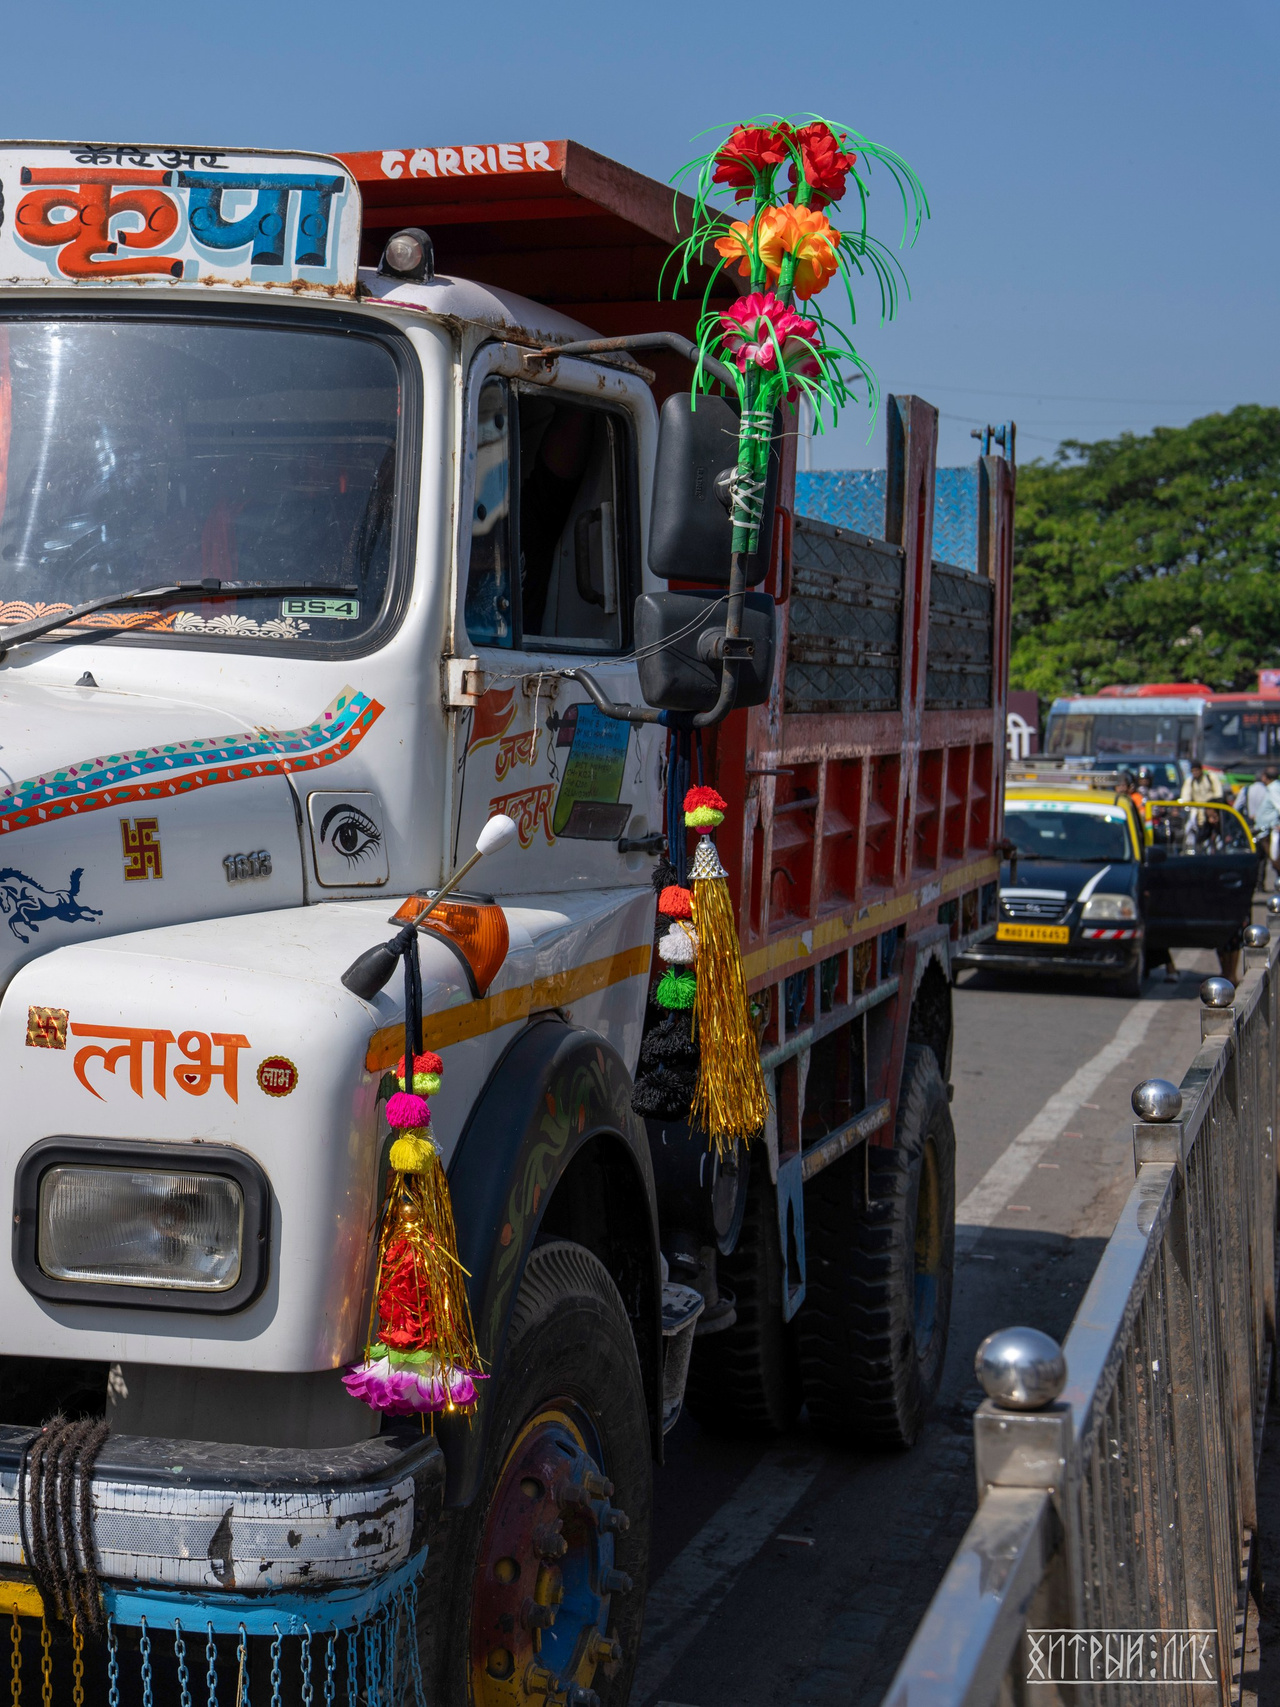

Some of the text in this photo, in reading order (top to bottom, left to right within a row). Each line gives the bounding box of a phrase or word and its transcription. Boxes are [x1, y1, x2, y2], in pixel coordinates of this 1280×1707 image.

[381, 141, 555, 179] CARRIER
[16, 167, 345, 278] कृपा
[288, 600, 354, 615] BS-4
[223, 851, 272, 882] 1613
[70, 1022, 252, 1105] लाभ
[261, 1067, 291, 1087] लाभ
